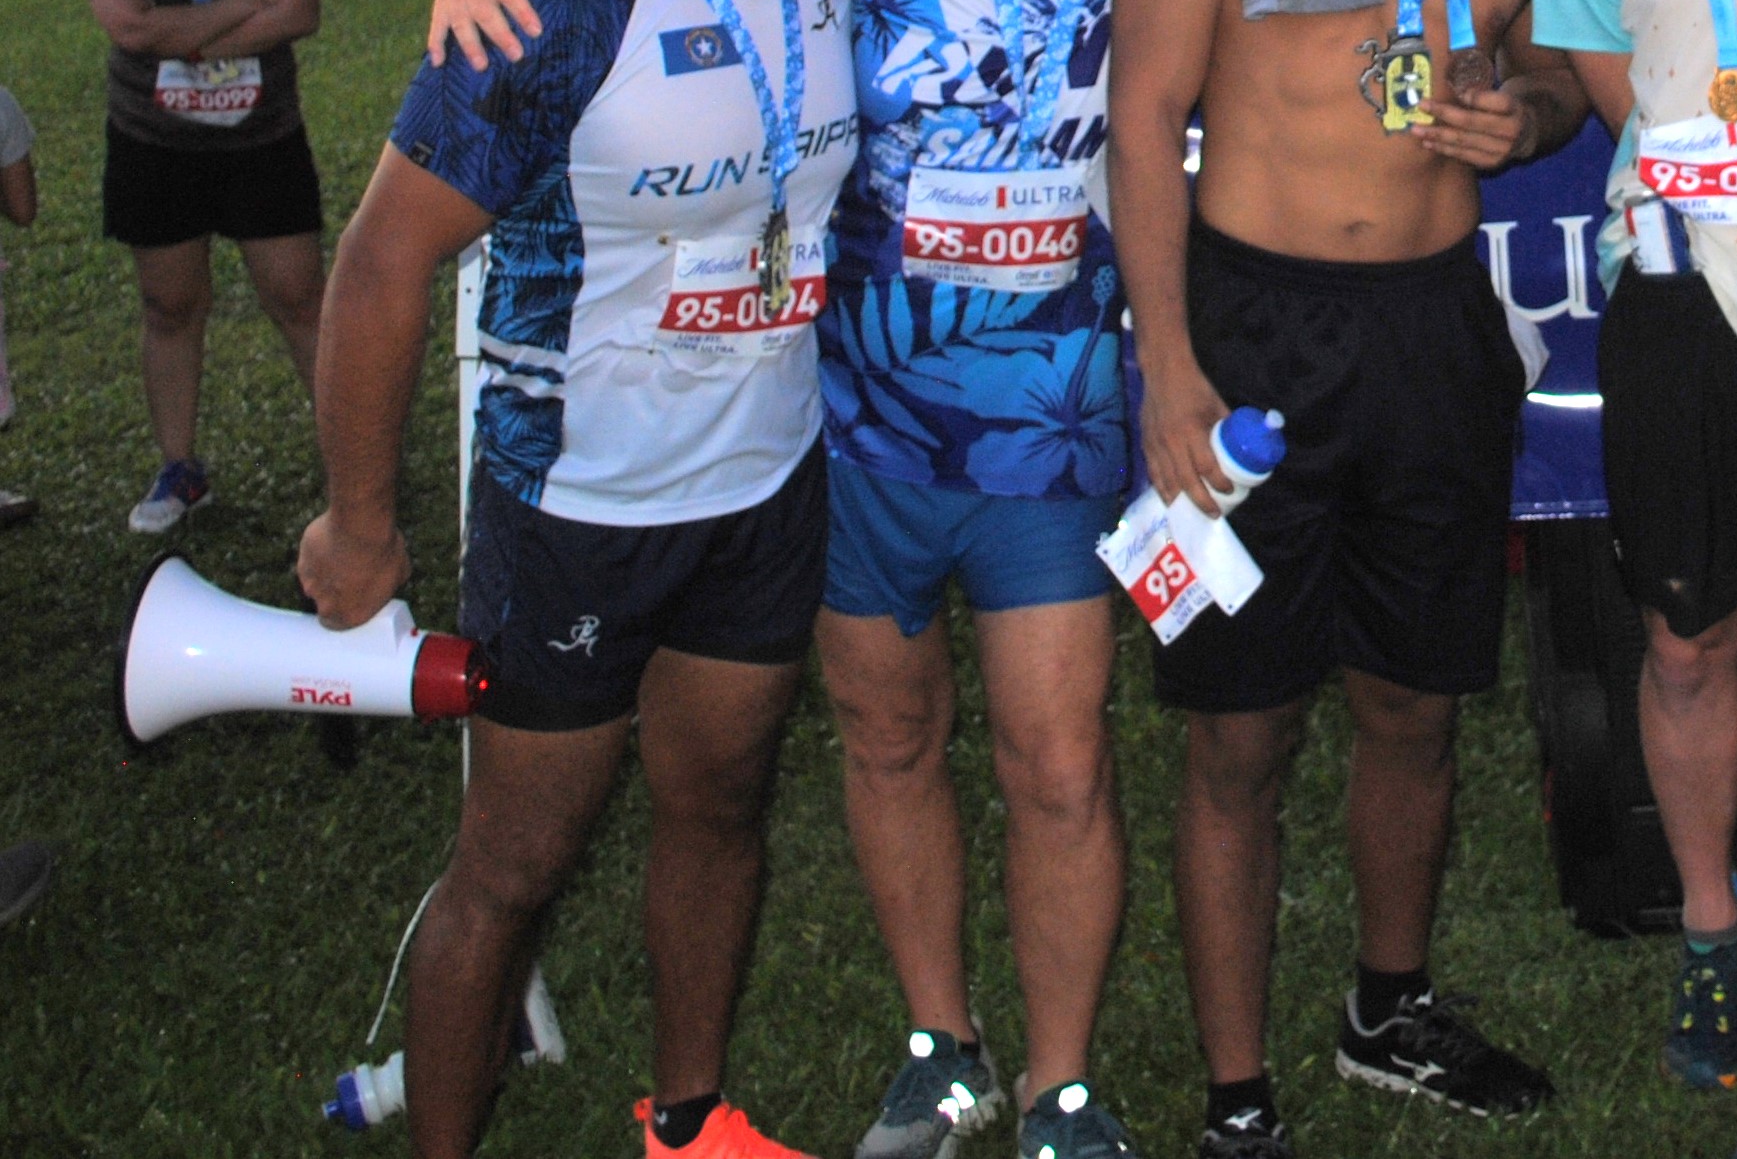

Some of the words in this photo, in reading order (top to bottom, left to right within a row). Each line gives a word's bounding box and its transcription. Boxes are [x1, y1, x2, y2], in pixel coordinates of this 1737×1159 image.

[630, 151, 751, 197] RUN
[1012, 185, 1085, 206] ULTRA
[915, 223, 1079, 262] 95-0046
[292, 687, 351, 706] PYLE
